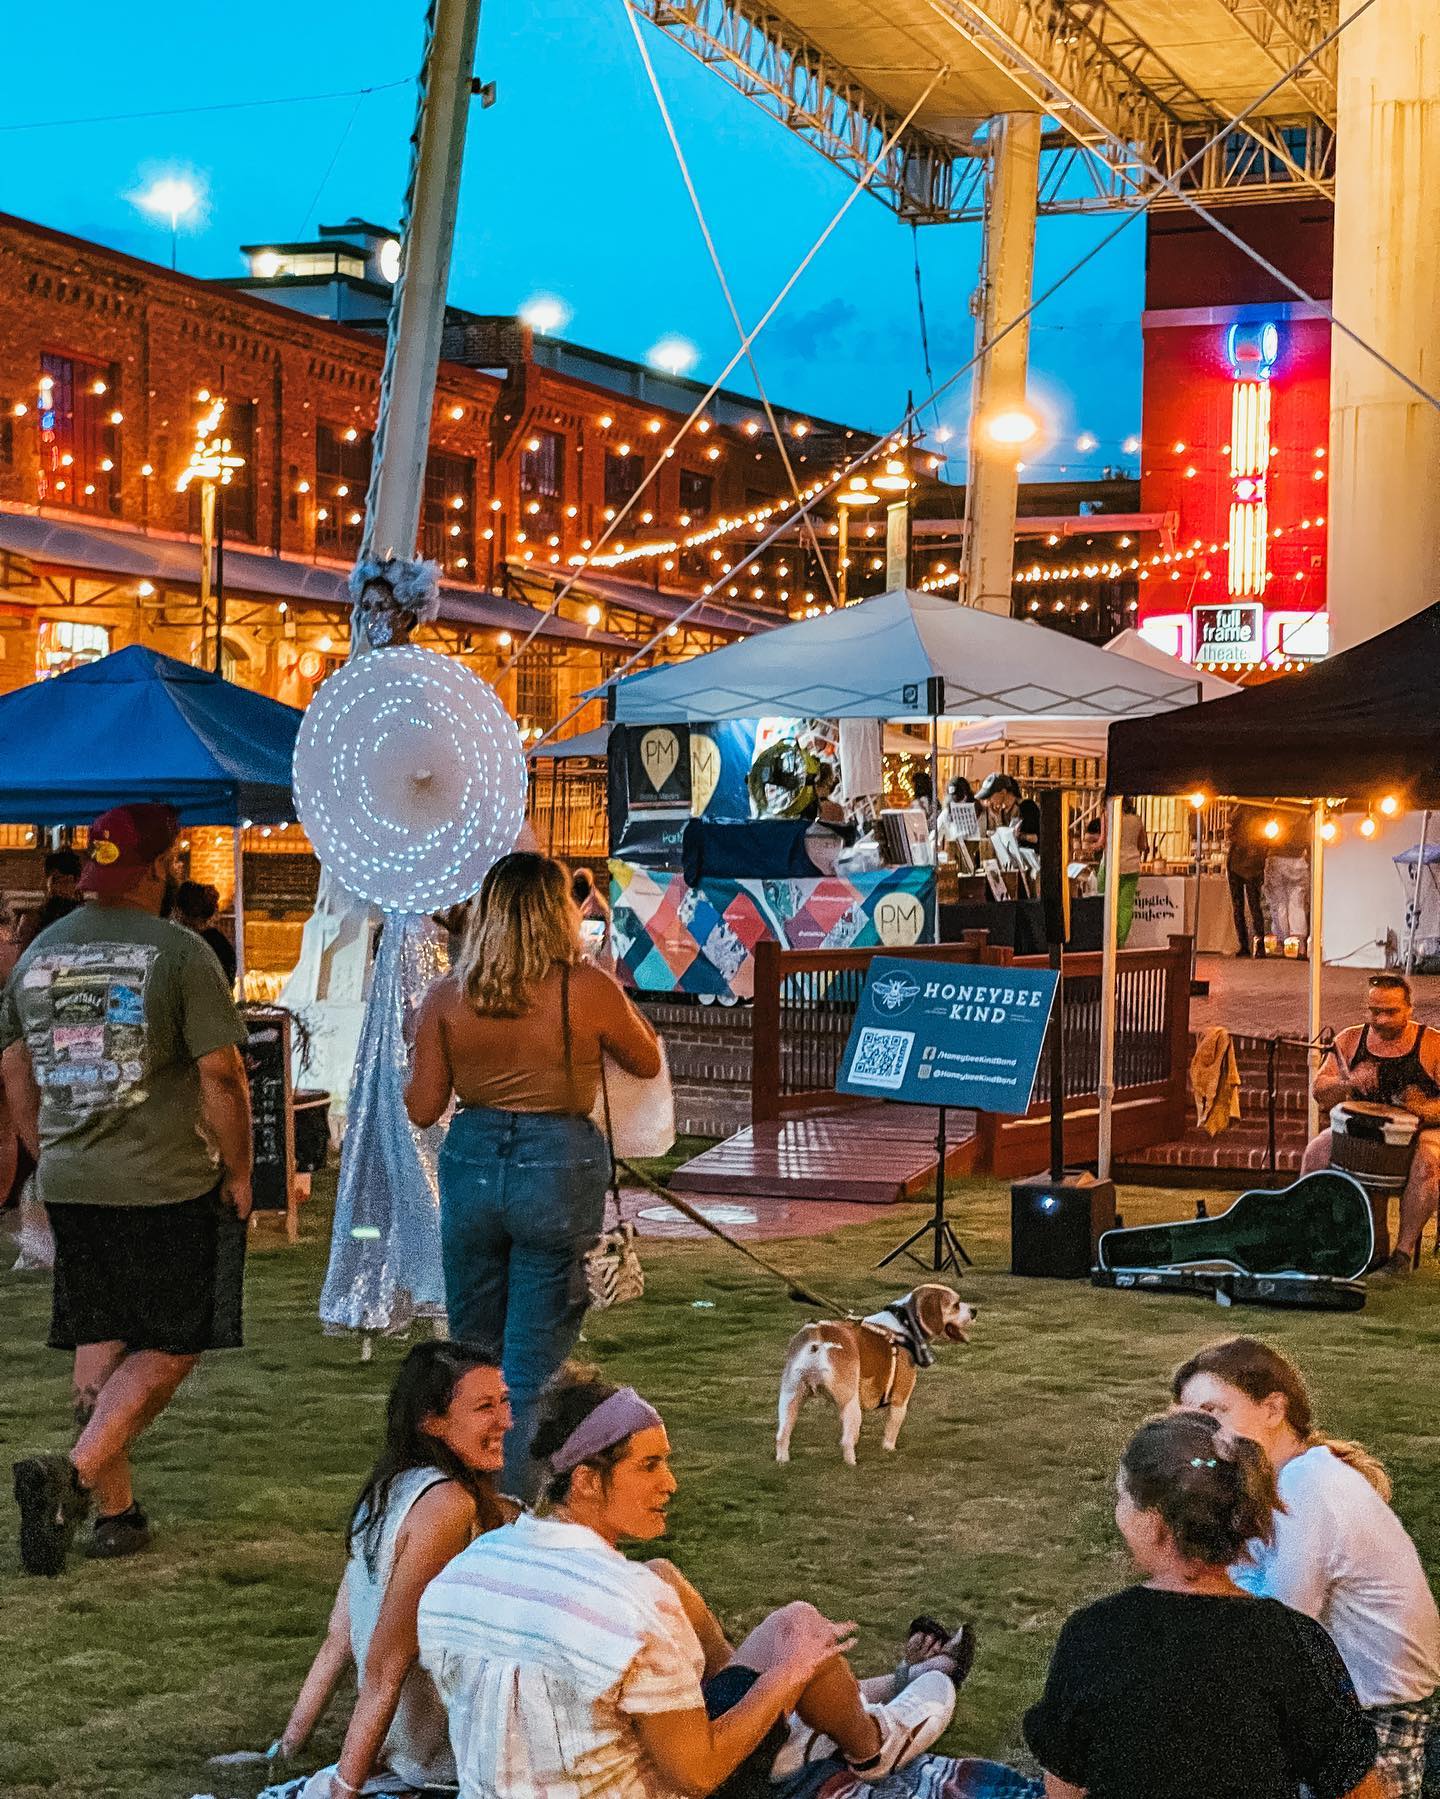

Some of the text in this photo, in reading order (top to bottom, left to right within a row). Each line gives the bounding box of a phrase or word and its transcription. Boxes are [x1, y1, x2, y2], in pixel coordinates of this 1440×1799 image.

[1216, 609, 1241, 628] full
[1203, 622, 1251, 642] frame
[645, 740, 674, 765] PM
[692, 751, 713, 788] M
[880, 904, 918, 935] PM
[923, 982, 1043, 1008] HONEYBEE
[948, 1003, 1006, 1024] KIND
